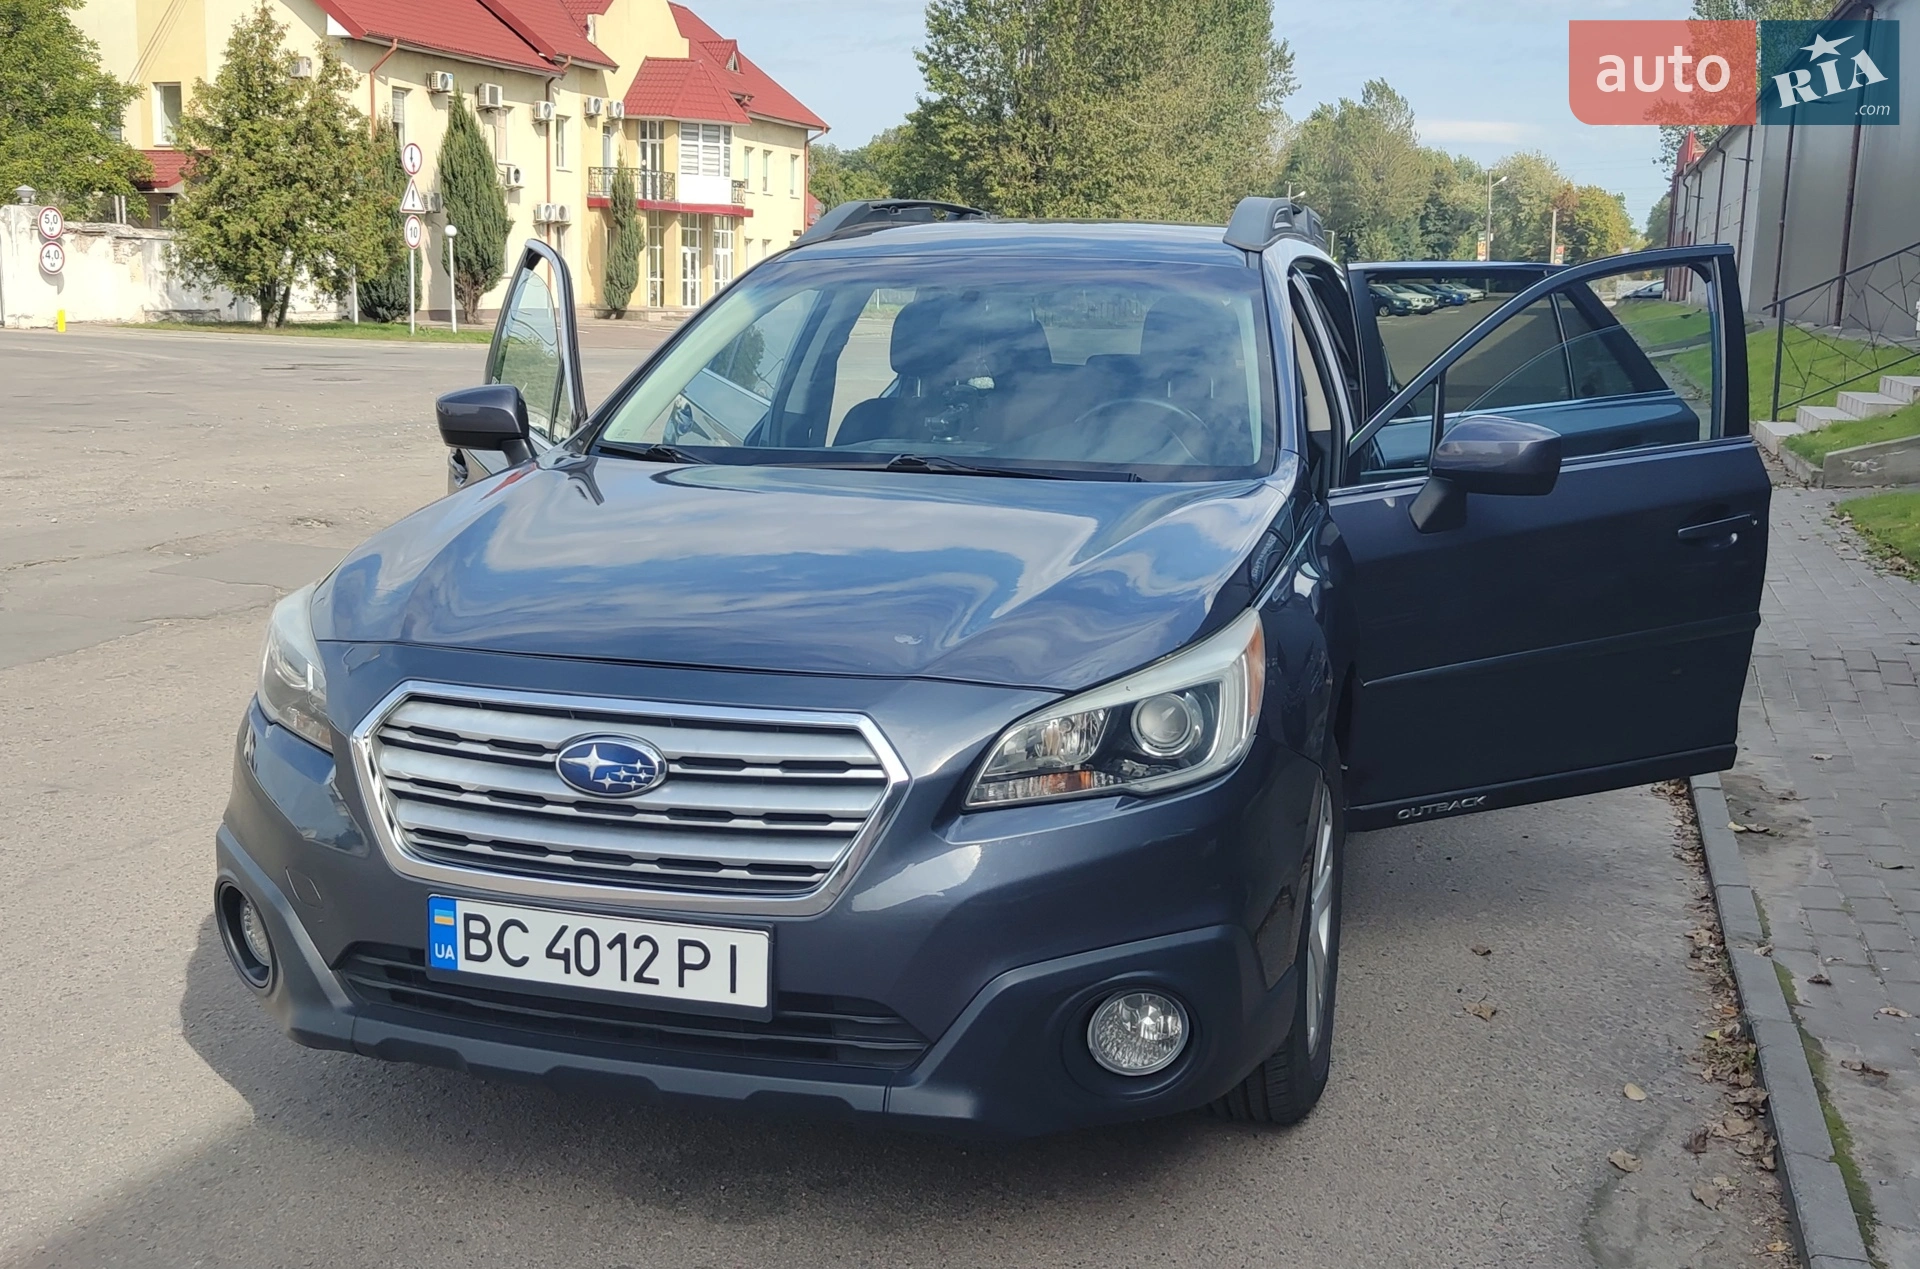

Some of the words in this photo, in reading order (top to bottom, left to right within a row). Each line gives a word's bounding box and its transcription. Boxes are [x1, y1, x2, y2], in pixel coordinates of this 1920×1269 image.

[44, 214, 58, 226] 5,0
[409, 226, 418, 239] 10
[45, 250, 60, 261] 4,0
[1397, 795, 1487, 819] OUTBACK
[434, 942, 456, 961] UA
[463, 912, 530, 968] BC
[545, 924, 660, 986] 4012
